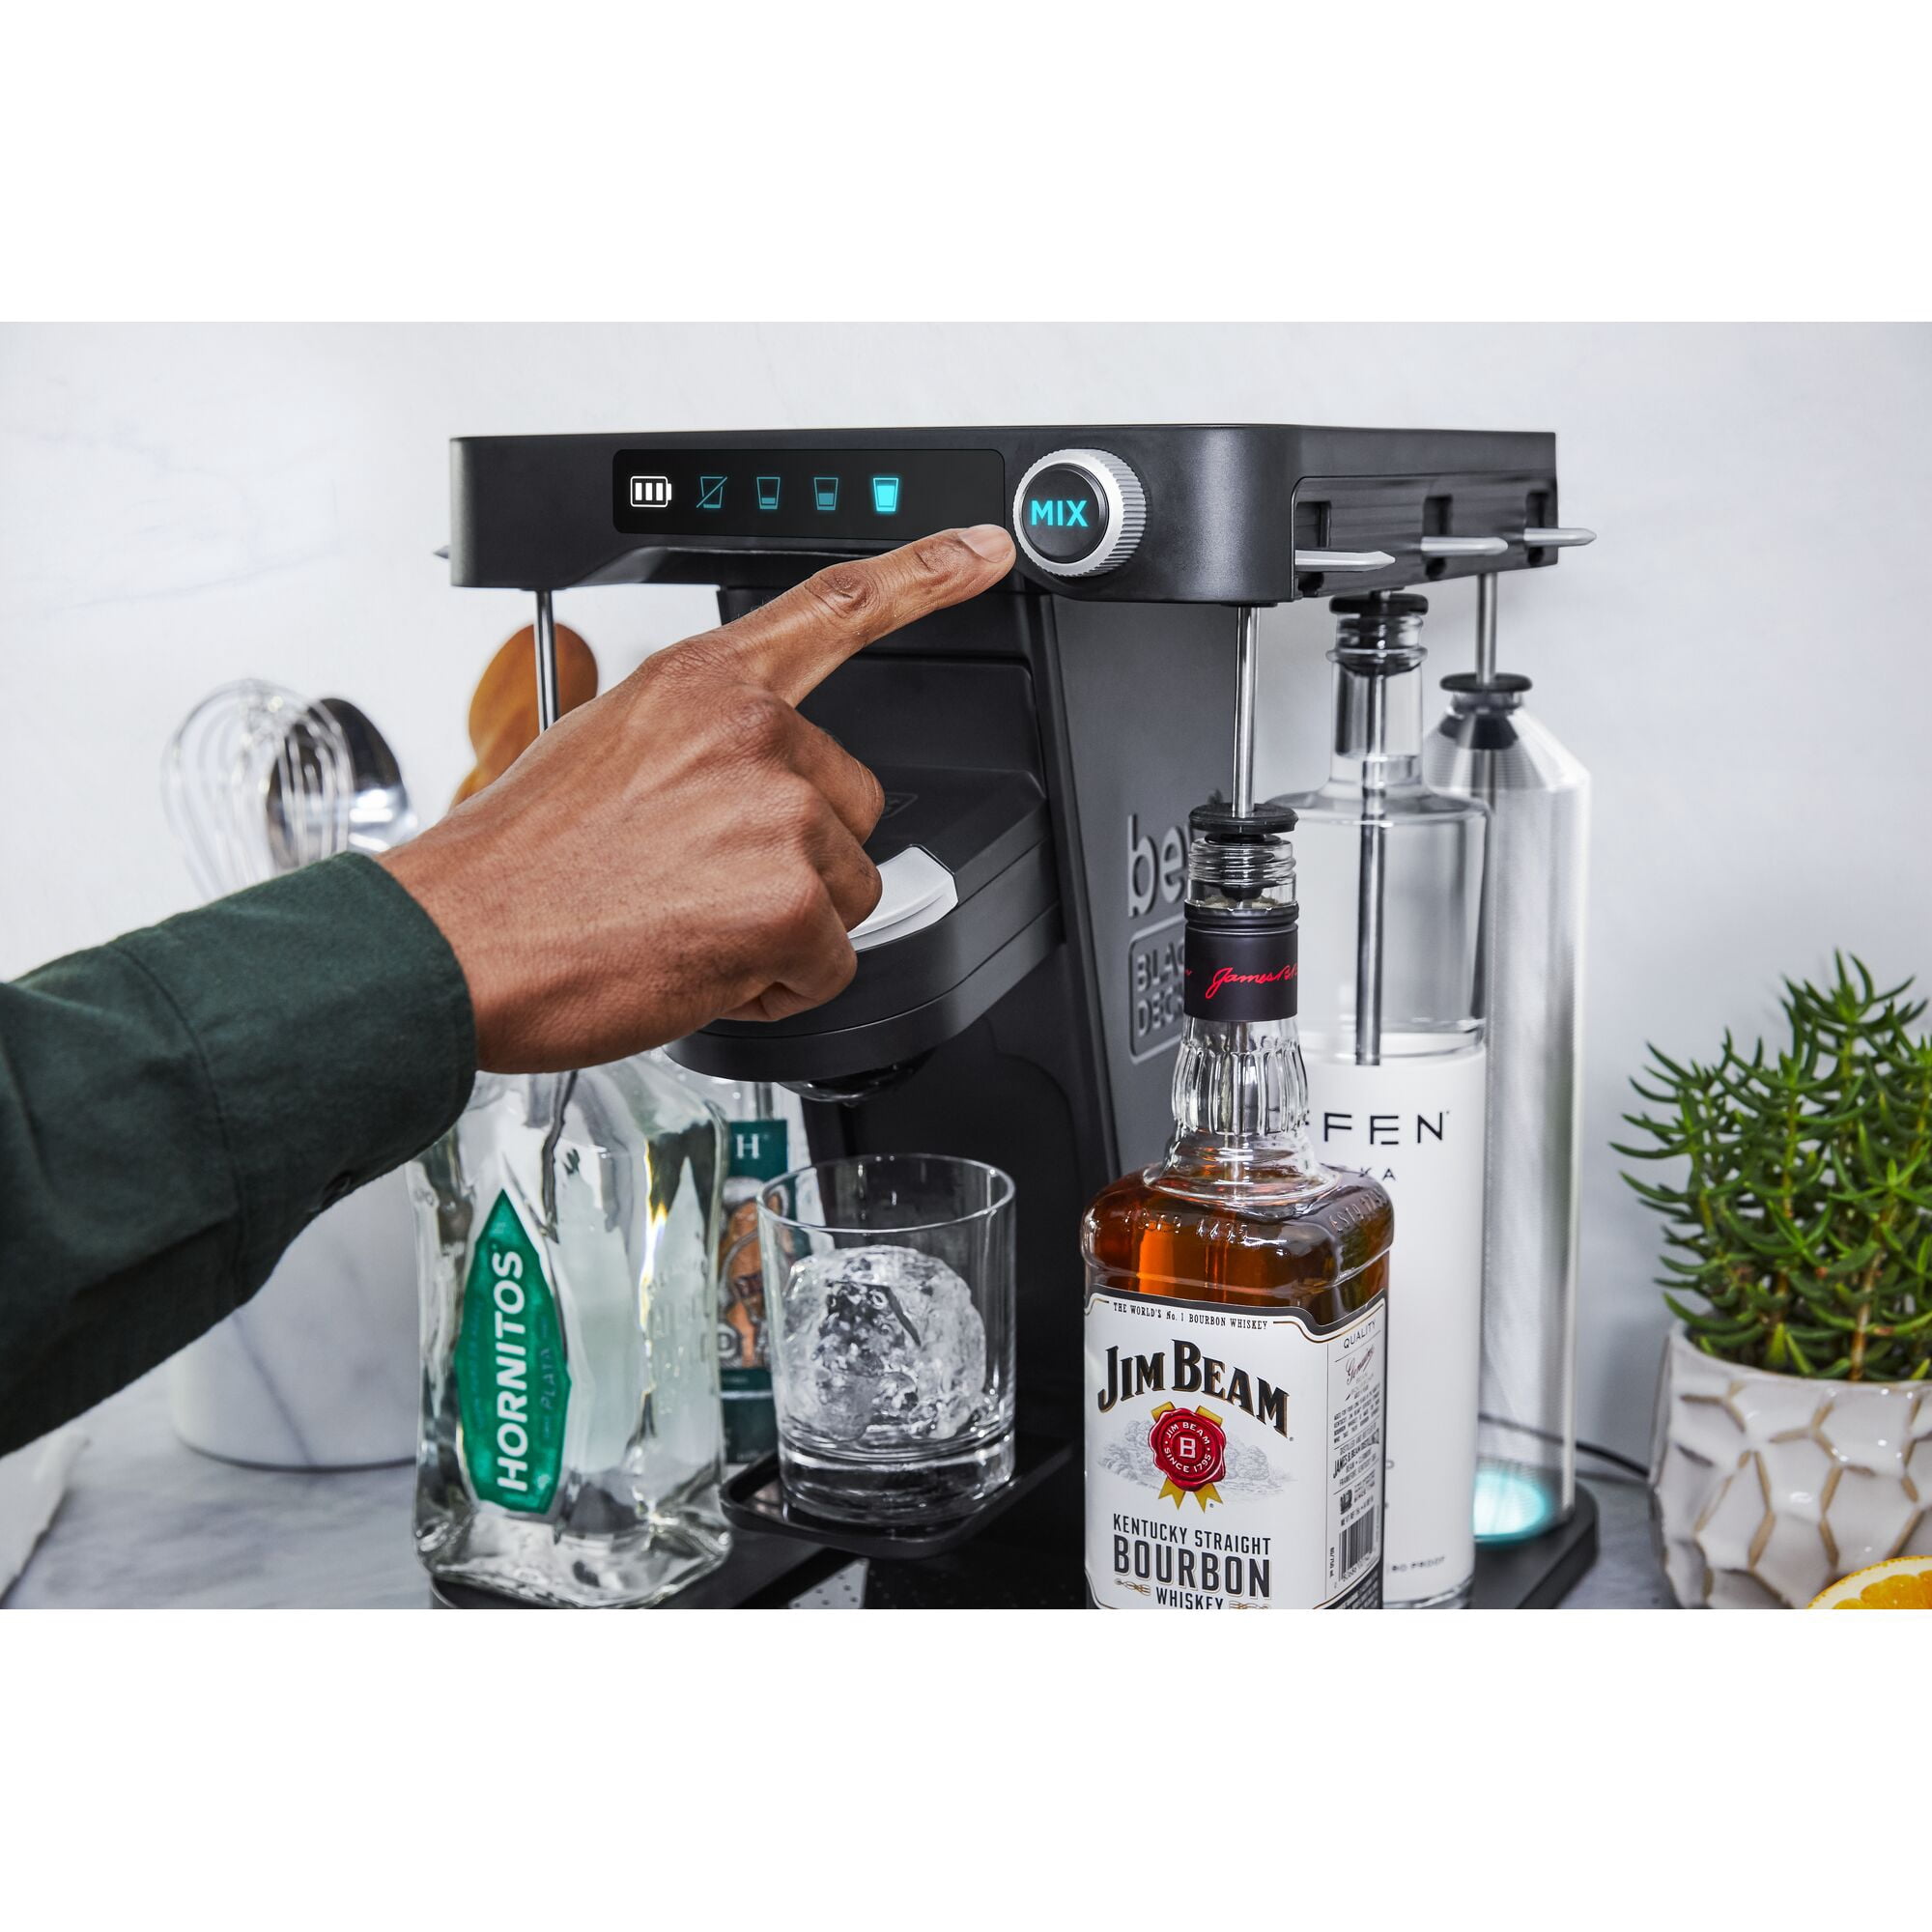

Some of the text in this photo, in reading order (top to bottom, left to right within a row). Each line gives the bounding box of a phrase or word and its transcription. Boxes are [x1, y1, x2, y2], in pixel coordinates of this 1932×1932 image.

[1031, 499, 1089, 526] MIX
[1305, 1110, 1443, 1145] FEN
[737, 1133, 759, 1159] H
[1114, 1302, 1127, 1313] THE
[1130, 1305, 1161, 1319] WORLD'S
[1189, 1314, 1226, 1326] BOURBON
[1230, 1319, 1267, 1330] WHISKEY
[1344, 1320, 1377, 1349] QUALITY
[492, 1251, 528, 1492] HORNITOS
[1097, 1346, 1166, 1413] JIM
[1171, 1339, 1290, 1438] BEAM
[1166, 1421, 1210, 1445] JIM BEAM
[1164, 1447, 1211, 1473] SINCE 1795
[1179, 1436, 1196, 1459] B
[1114, 1513, 1271, 1554] KENTUCKY STRAIGHT
[1114, 1534, 1270, 1598] BOURBON
[1156, 1587, 1224, 1609] WHISKEY
